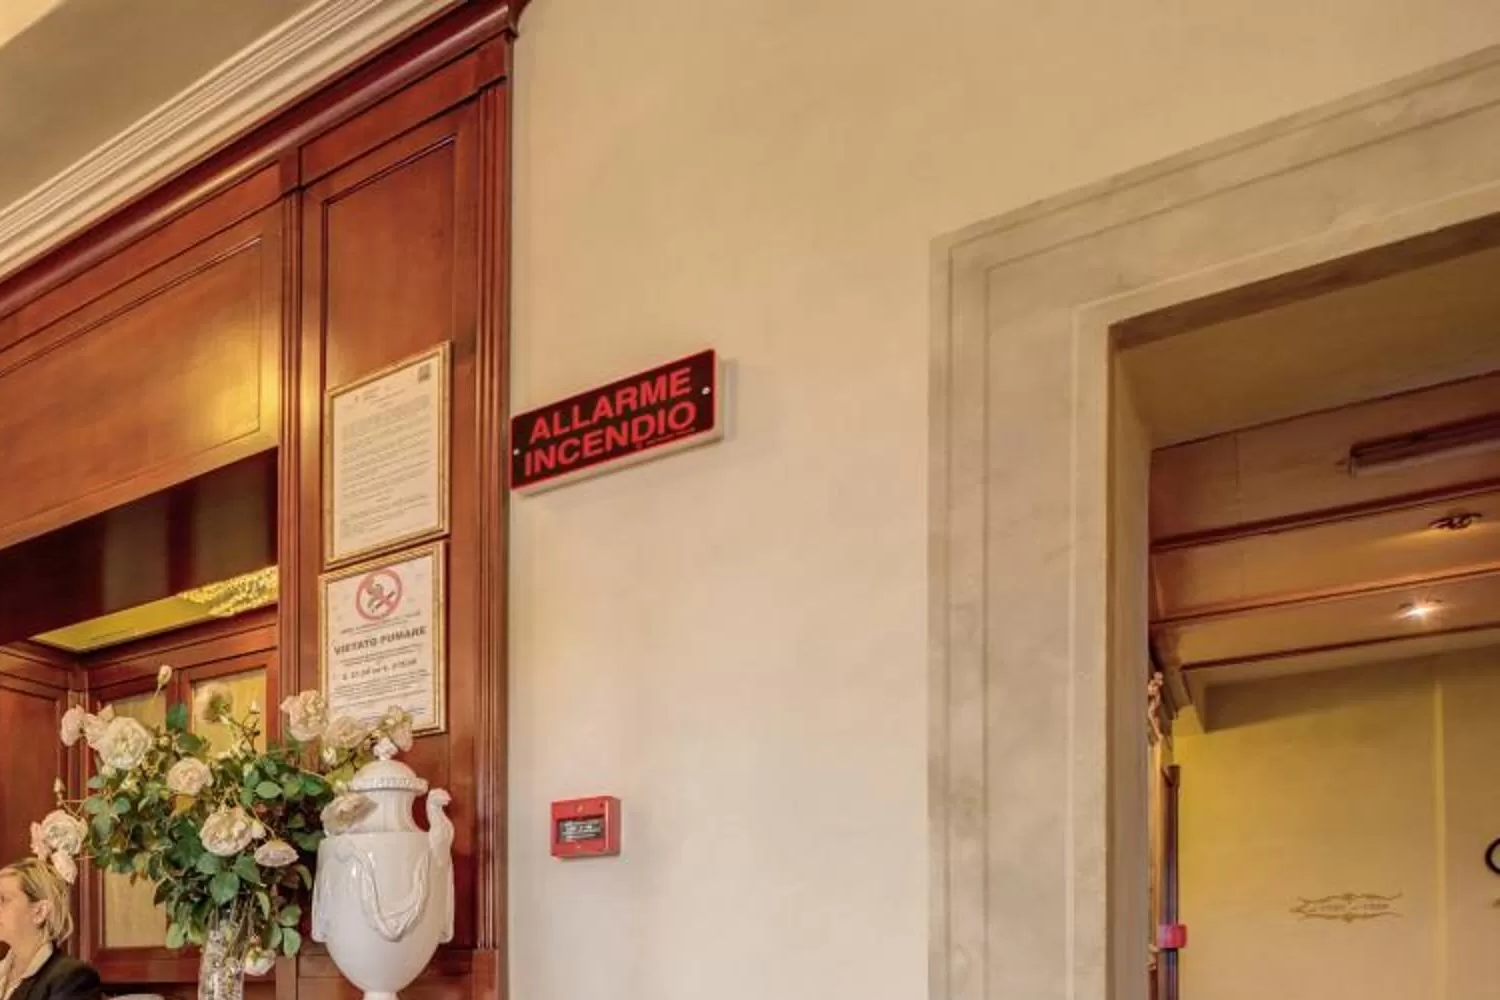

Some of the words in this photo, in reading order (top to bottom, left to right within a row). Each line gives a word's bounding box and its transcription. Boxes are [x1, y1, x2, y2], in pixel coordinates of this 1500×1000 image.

[524, 401, 697, 476] INCENDIO
[529, 367, 692, 444] ALLARME
[334, 637, 377, 655] VIETATO
[380, 626, 427, 643] FUMARE
